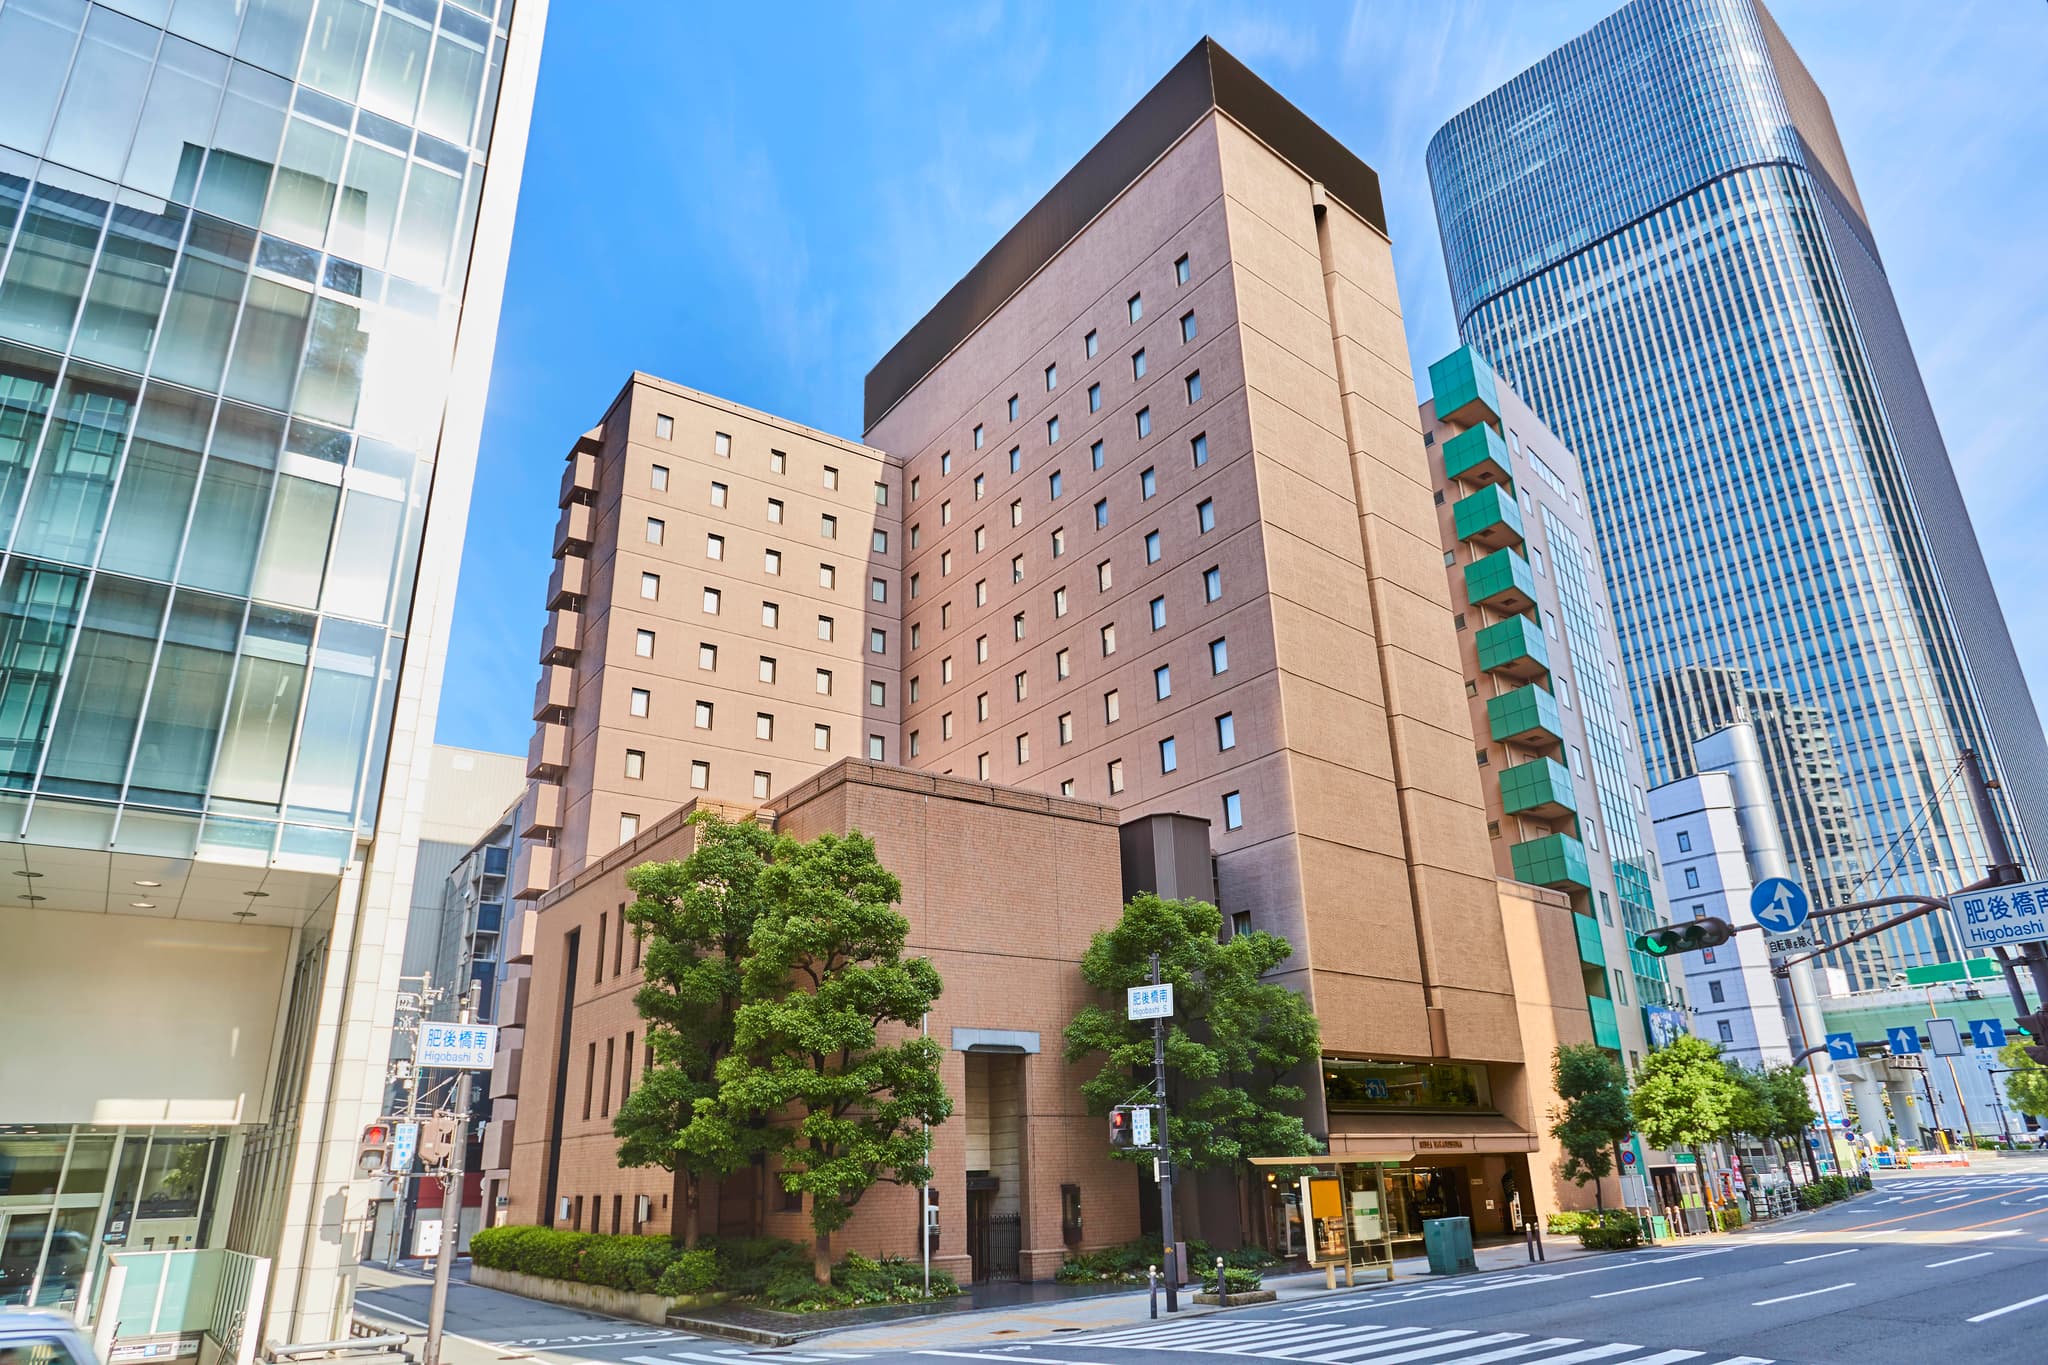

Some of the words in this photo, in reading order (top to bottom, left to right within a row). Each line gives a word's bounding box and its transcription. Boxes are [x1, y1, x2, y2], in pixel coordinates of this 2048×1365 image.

[1970, 919, 2045, 943] Higobashi
[426, 1028, 488, 1050] 肥後橋南
[424, 1050, 471, 1063] Higobashi
